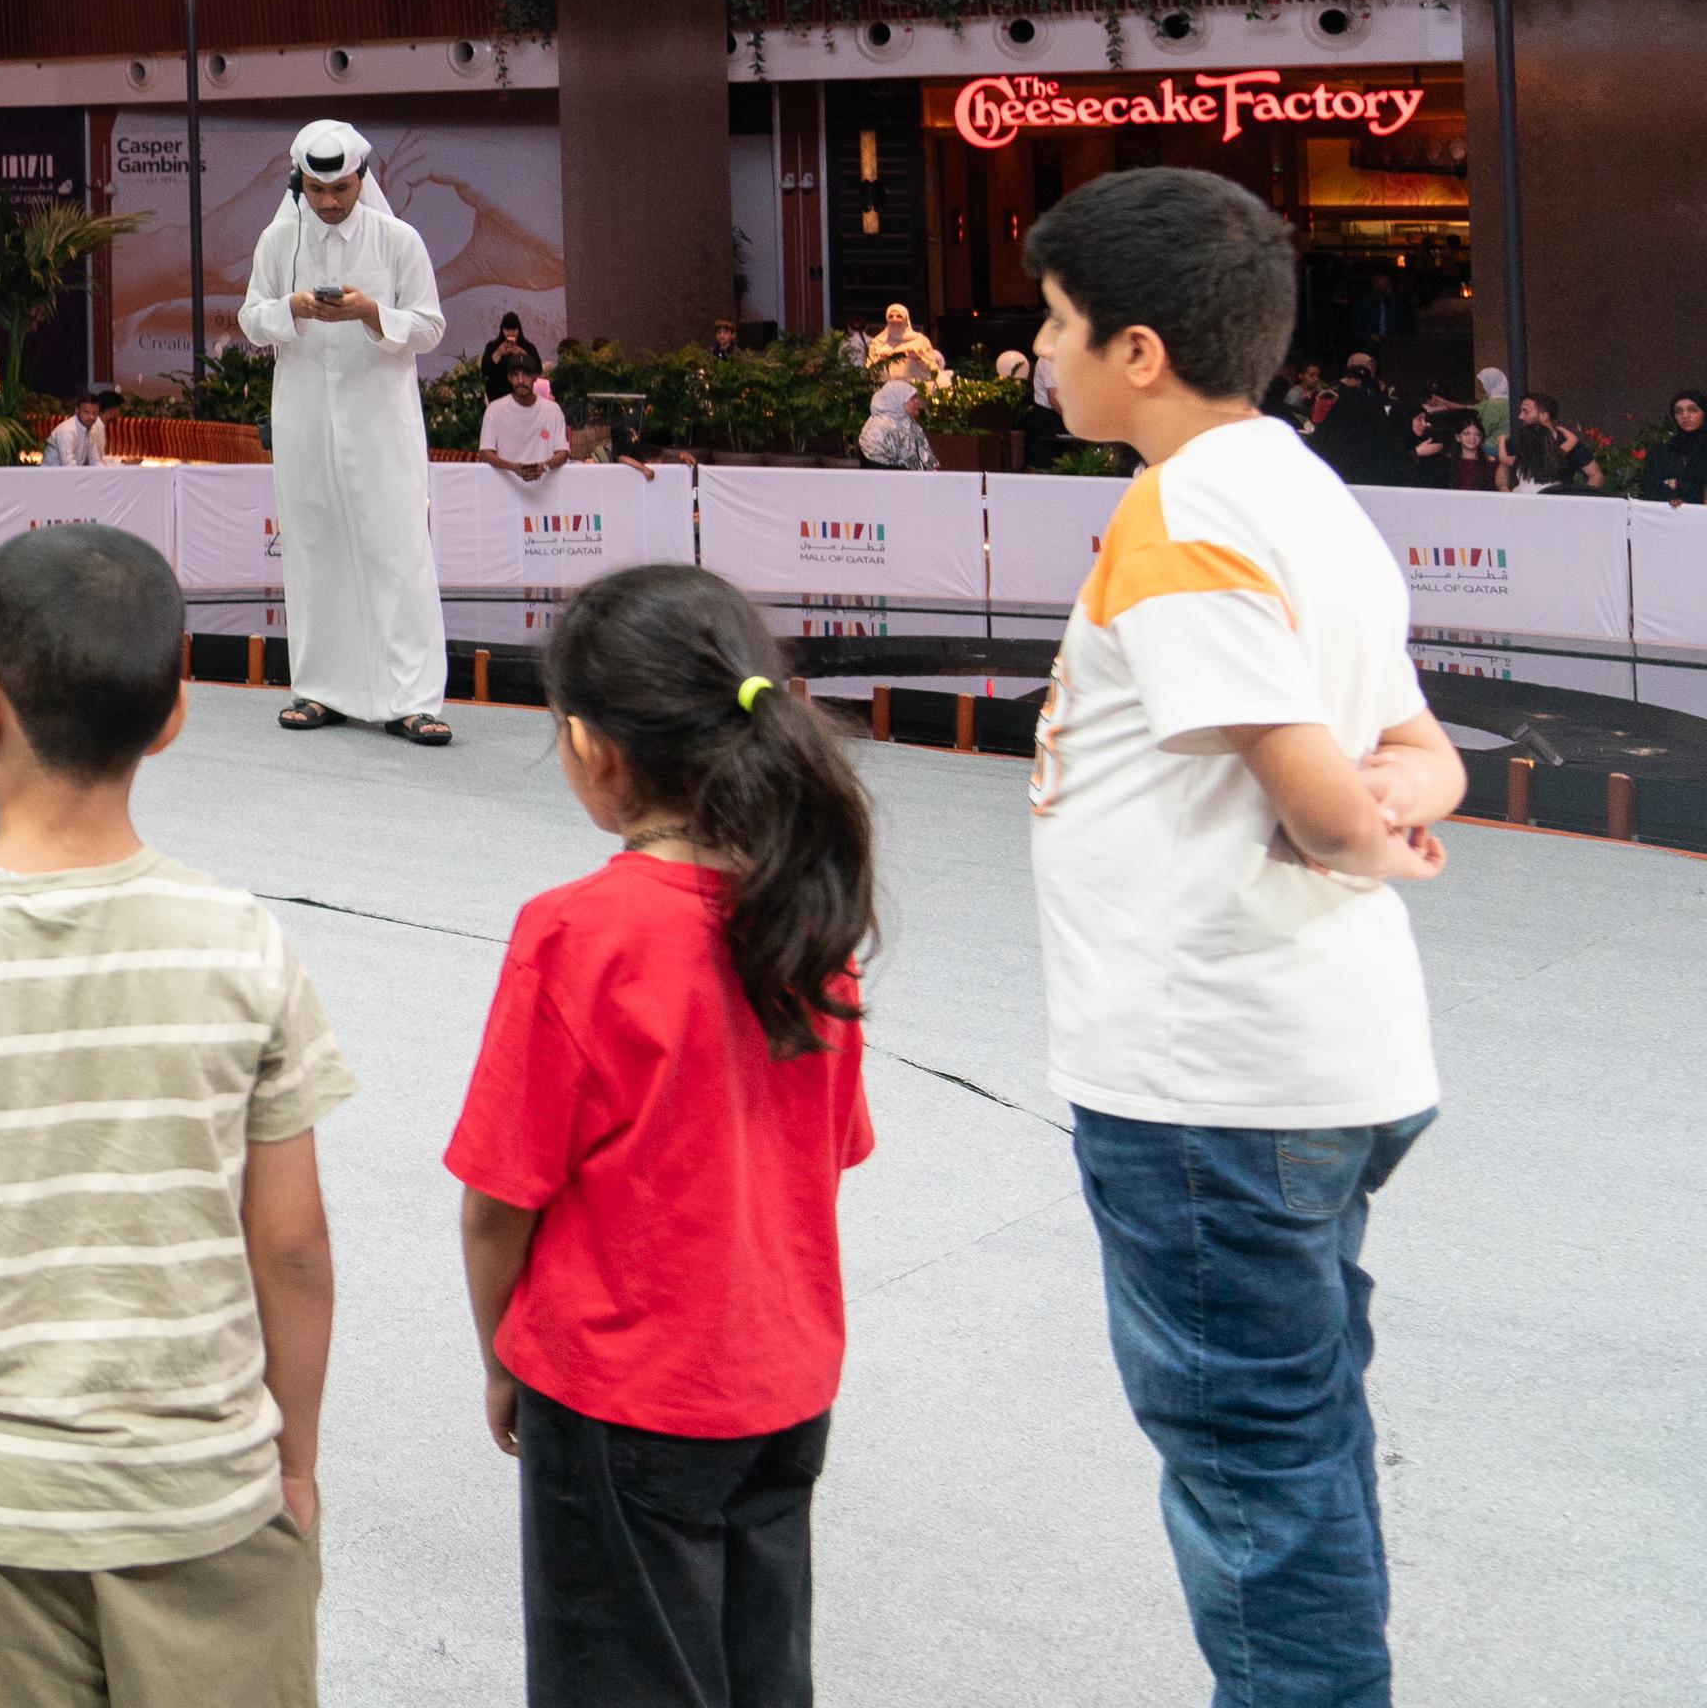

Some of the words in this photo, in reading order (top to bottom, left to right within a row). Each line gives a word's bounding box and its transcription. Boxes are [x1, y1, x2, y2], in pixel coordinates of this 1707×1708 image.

[1013, 76, 1060, 99] The
[953, 76, 1219, 149] Cheesecake
[1195, 70, 1425, 143] Factory
[117, 137, 183, 159] Casper
[524, 548, 550, 556] MALL
[551, 547, 565, 556] OF
[566, 547, 603, 555] QATAR
[800, 553, 826, 563] MALL
[828, 554, 844, 563] OF
[845, 555, 886, 566] QATAR
[1410, 583, 1442, 593] MALL
[1443, 583, 1461, 593] OF
[1462, 584, 1509, 596] QATAR
